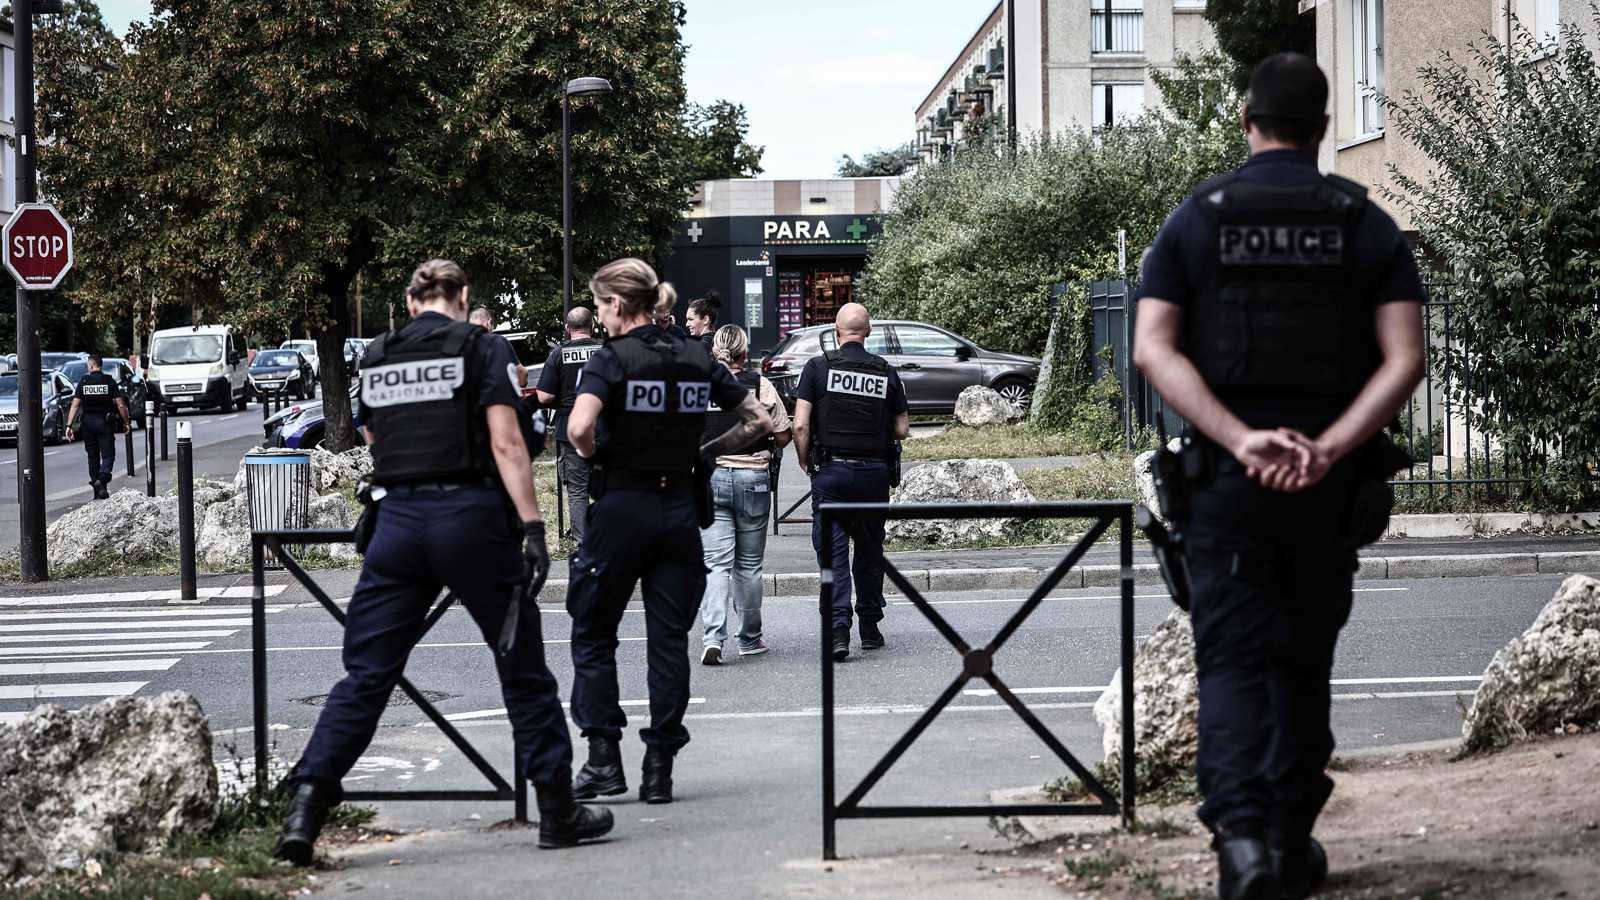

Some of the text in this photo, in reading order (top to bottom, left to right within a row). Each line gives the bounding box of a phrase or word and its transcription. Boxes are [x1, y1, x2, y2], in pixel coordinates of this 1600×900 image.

[764, 220, 831, 239] PARA
[13, 235, 64, 258] STOP
[1224, 229, 1340, 256] POLICE
[563, 350, 598, 362] POLI
[369, 363, 457, 390] POLICE
[830, 373, 885, 396] POLICE
[84, 385, 108, 394] POLICE
[631, 385, 708, 408] POICE
